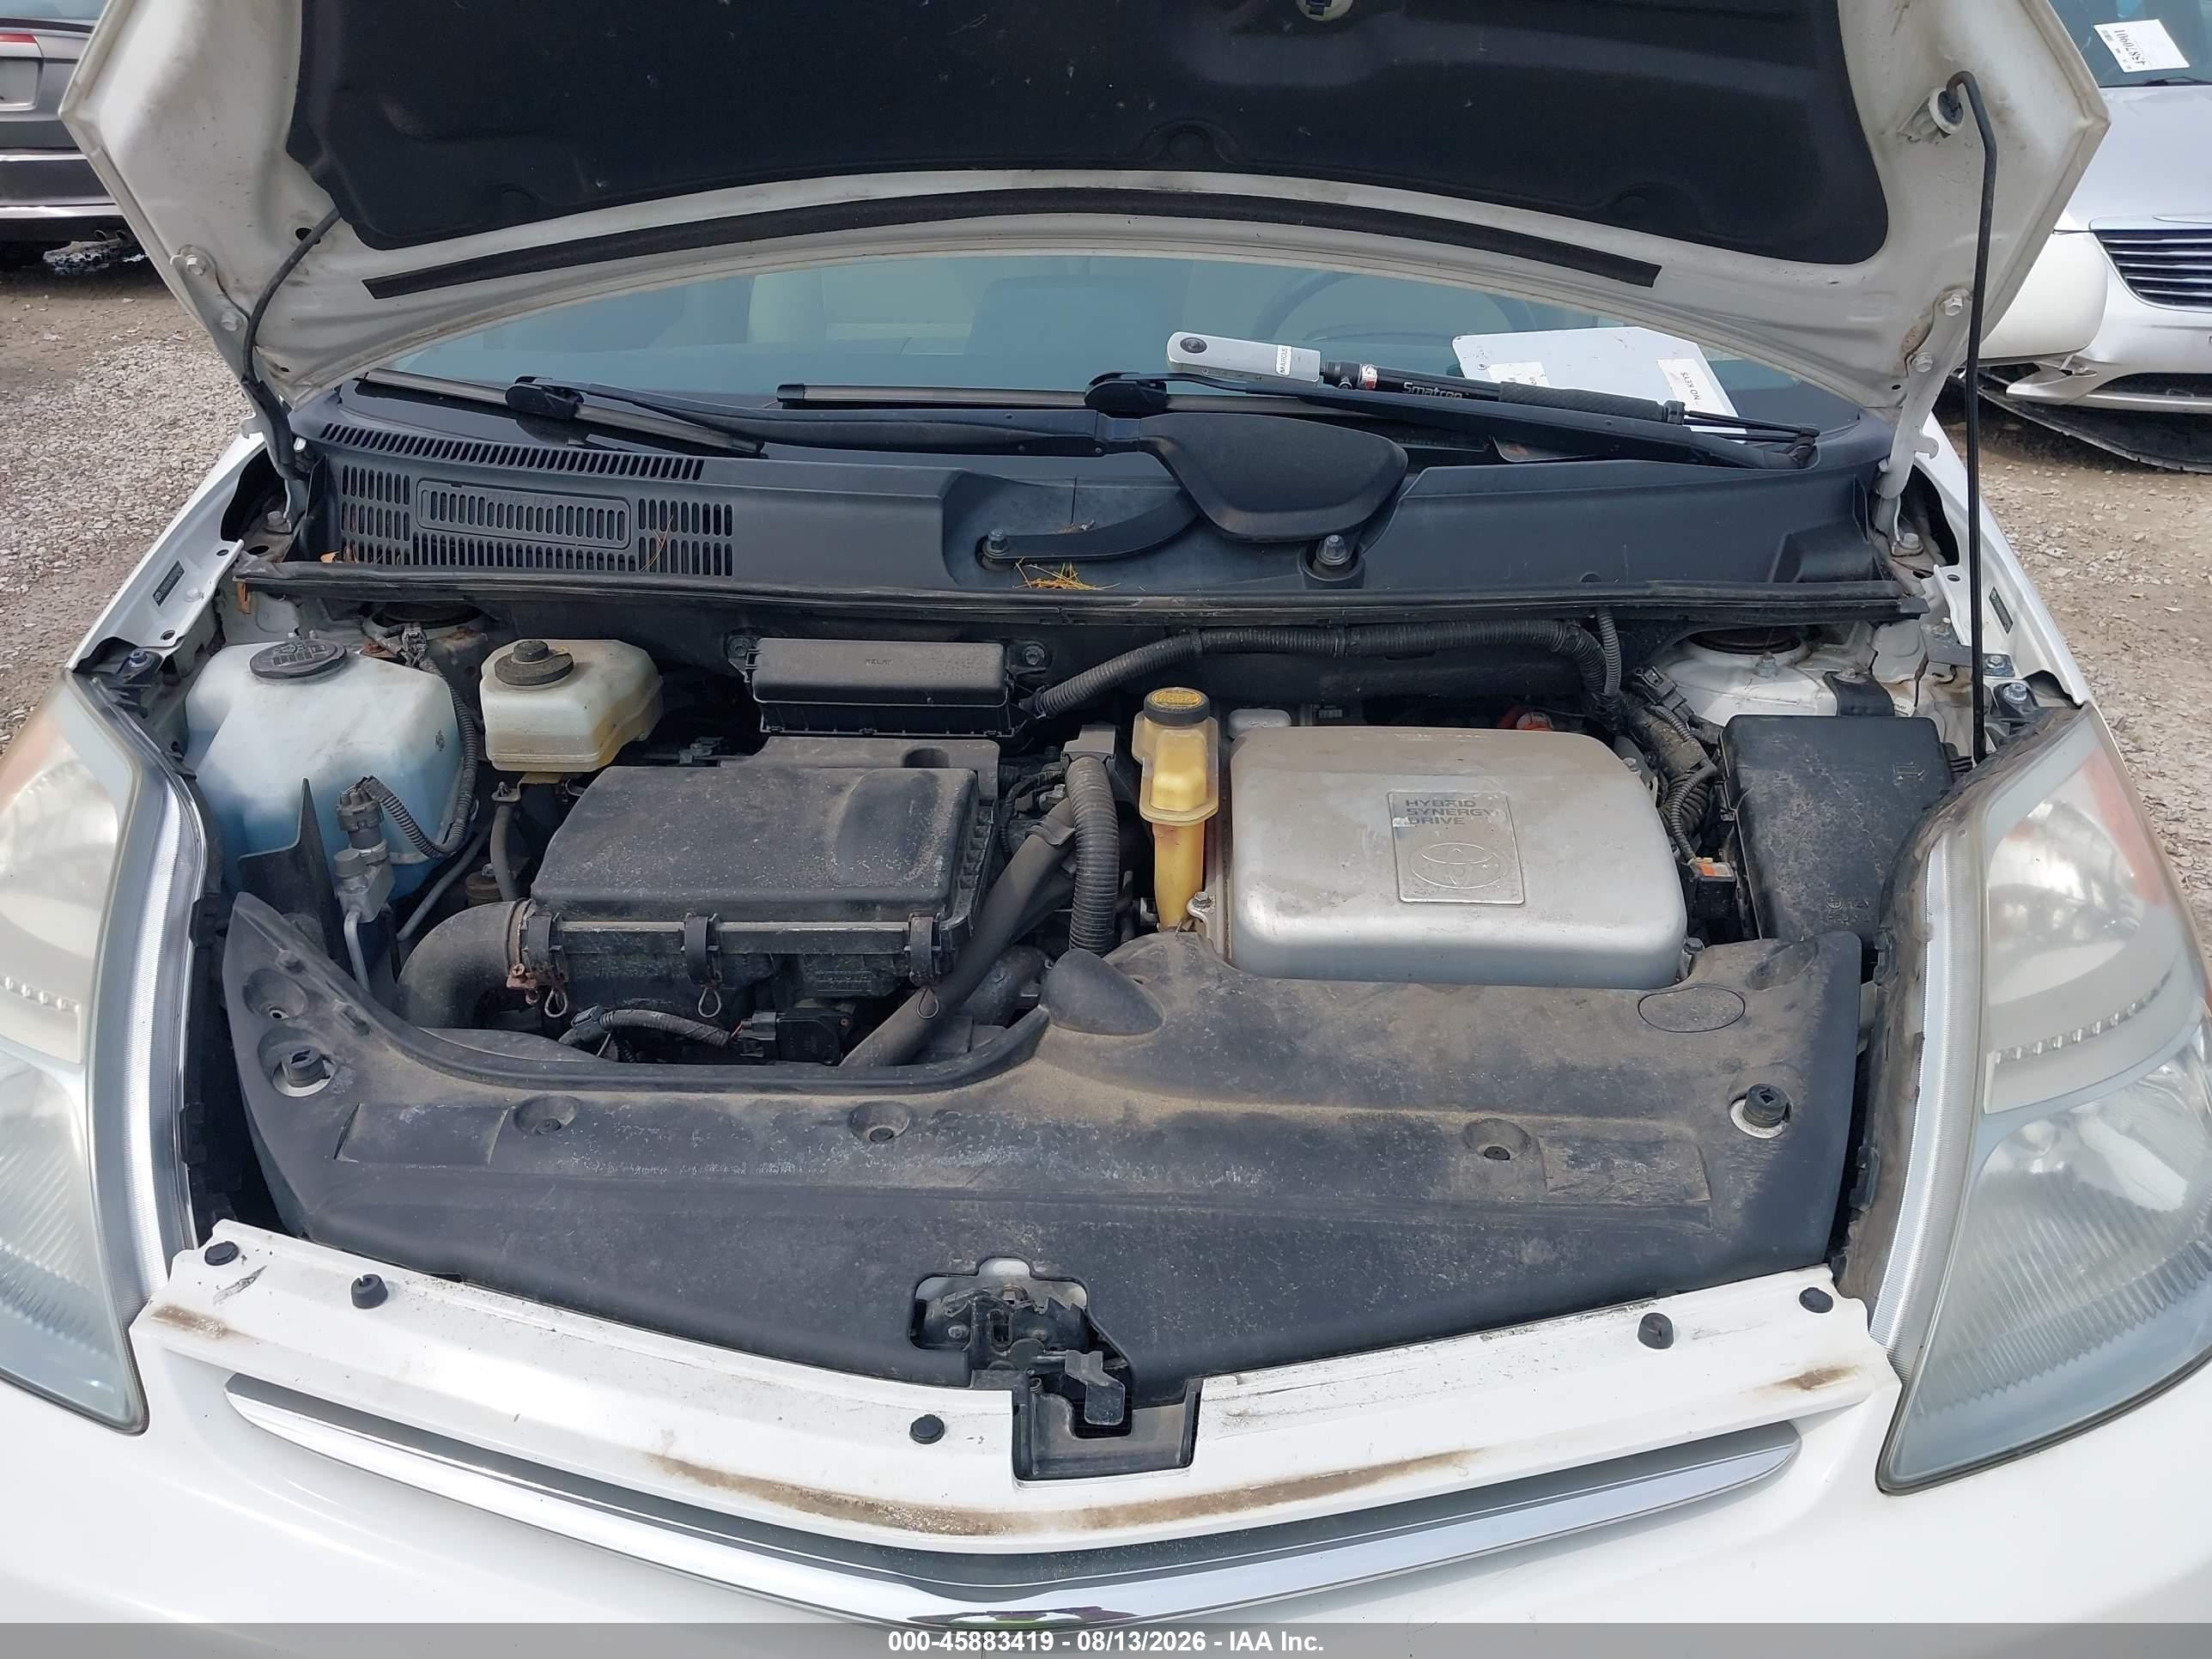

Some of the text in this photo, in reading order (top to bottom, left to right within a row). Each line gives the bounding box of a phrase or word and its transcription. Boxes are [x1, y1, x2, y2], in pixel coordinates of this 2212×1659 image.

[2114, 29, 2146, 65] 45870901
[1279, 347, 1288, 374] MARCUS
[1680, 371, 1702, 400] NO KEYS
